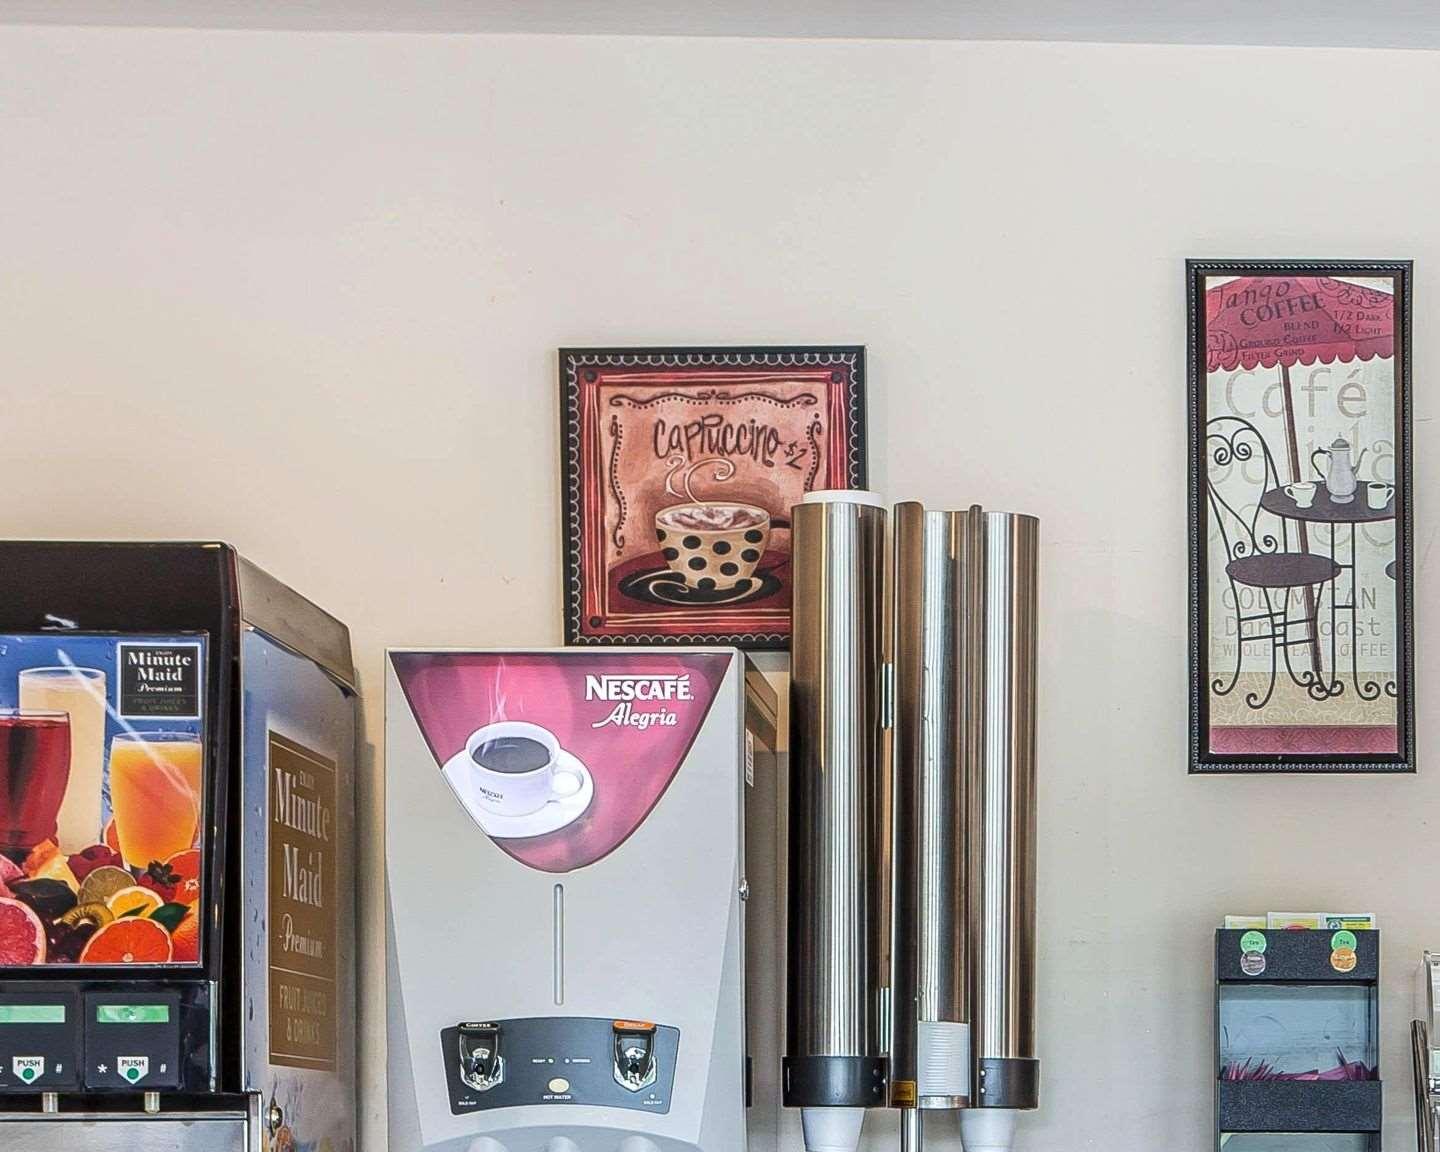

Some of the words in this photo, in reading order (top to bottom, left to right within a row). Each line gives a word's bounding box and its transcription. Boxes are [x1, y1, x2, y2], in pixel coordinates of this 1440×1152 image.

[1240, 293, 1327, 327] COFFEE
[1222, 586, 1377, 610] COLOMIAN
[1225, 616, 1284, 637] Dar
[1304, 616, 1382, 637] oast
[128, 652, 192, 666] Minute
[137, 667, 183, 681] Maid
[592, 702, 677, 730] Alegria
[274, 767, 331, 842] Minute
[283, 843, 323, 908] Maid
[17, 1059, 41, 1067] PUSH
[121, 1059, 145, 1067] PUSH
